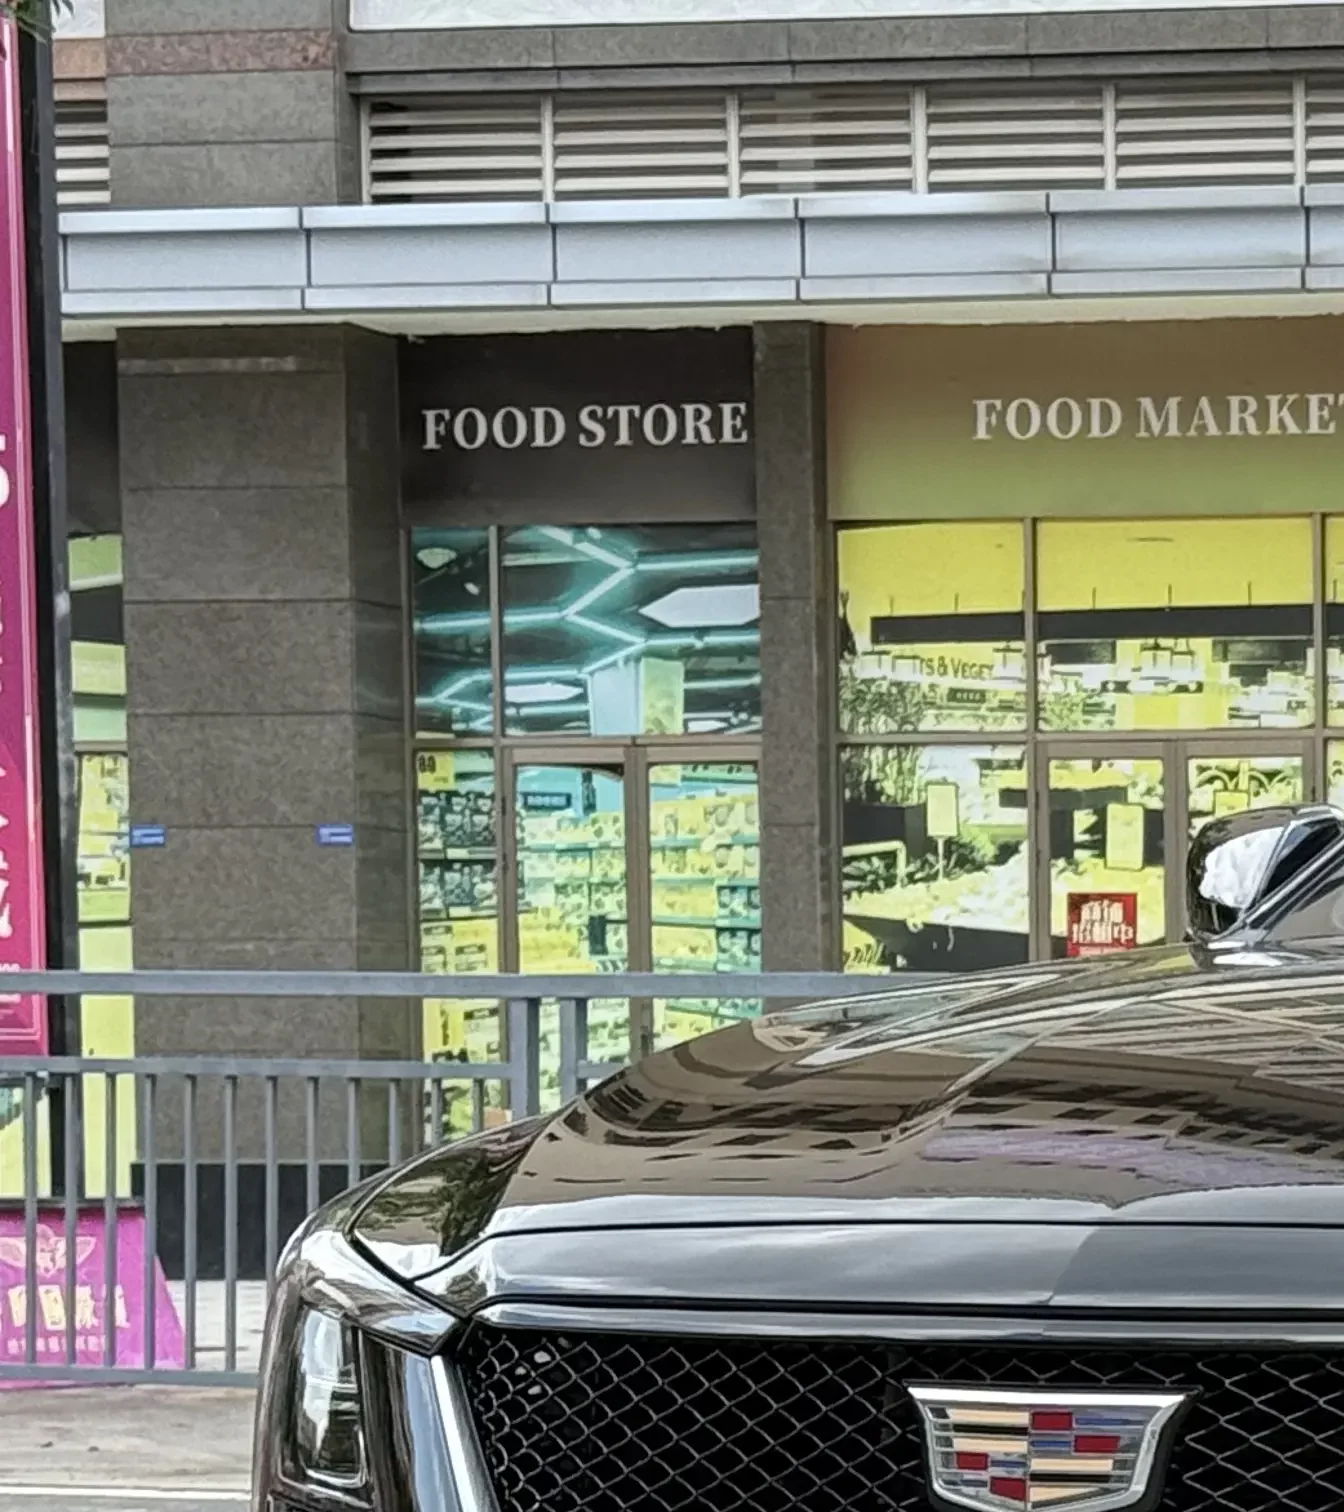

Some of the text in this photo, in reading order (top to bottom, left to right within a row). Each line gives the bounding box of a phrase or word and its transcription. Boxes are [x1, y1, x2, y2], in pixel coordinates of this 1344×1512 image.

[422, 403, 748, 450] FOOD STORE
[972, 397, 1123, 440] FOOD
